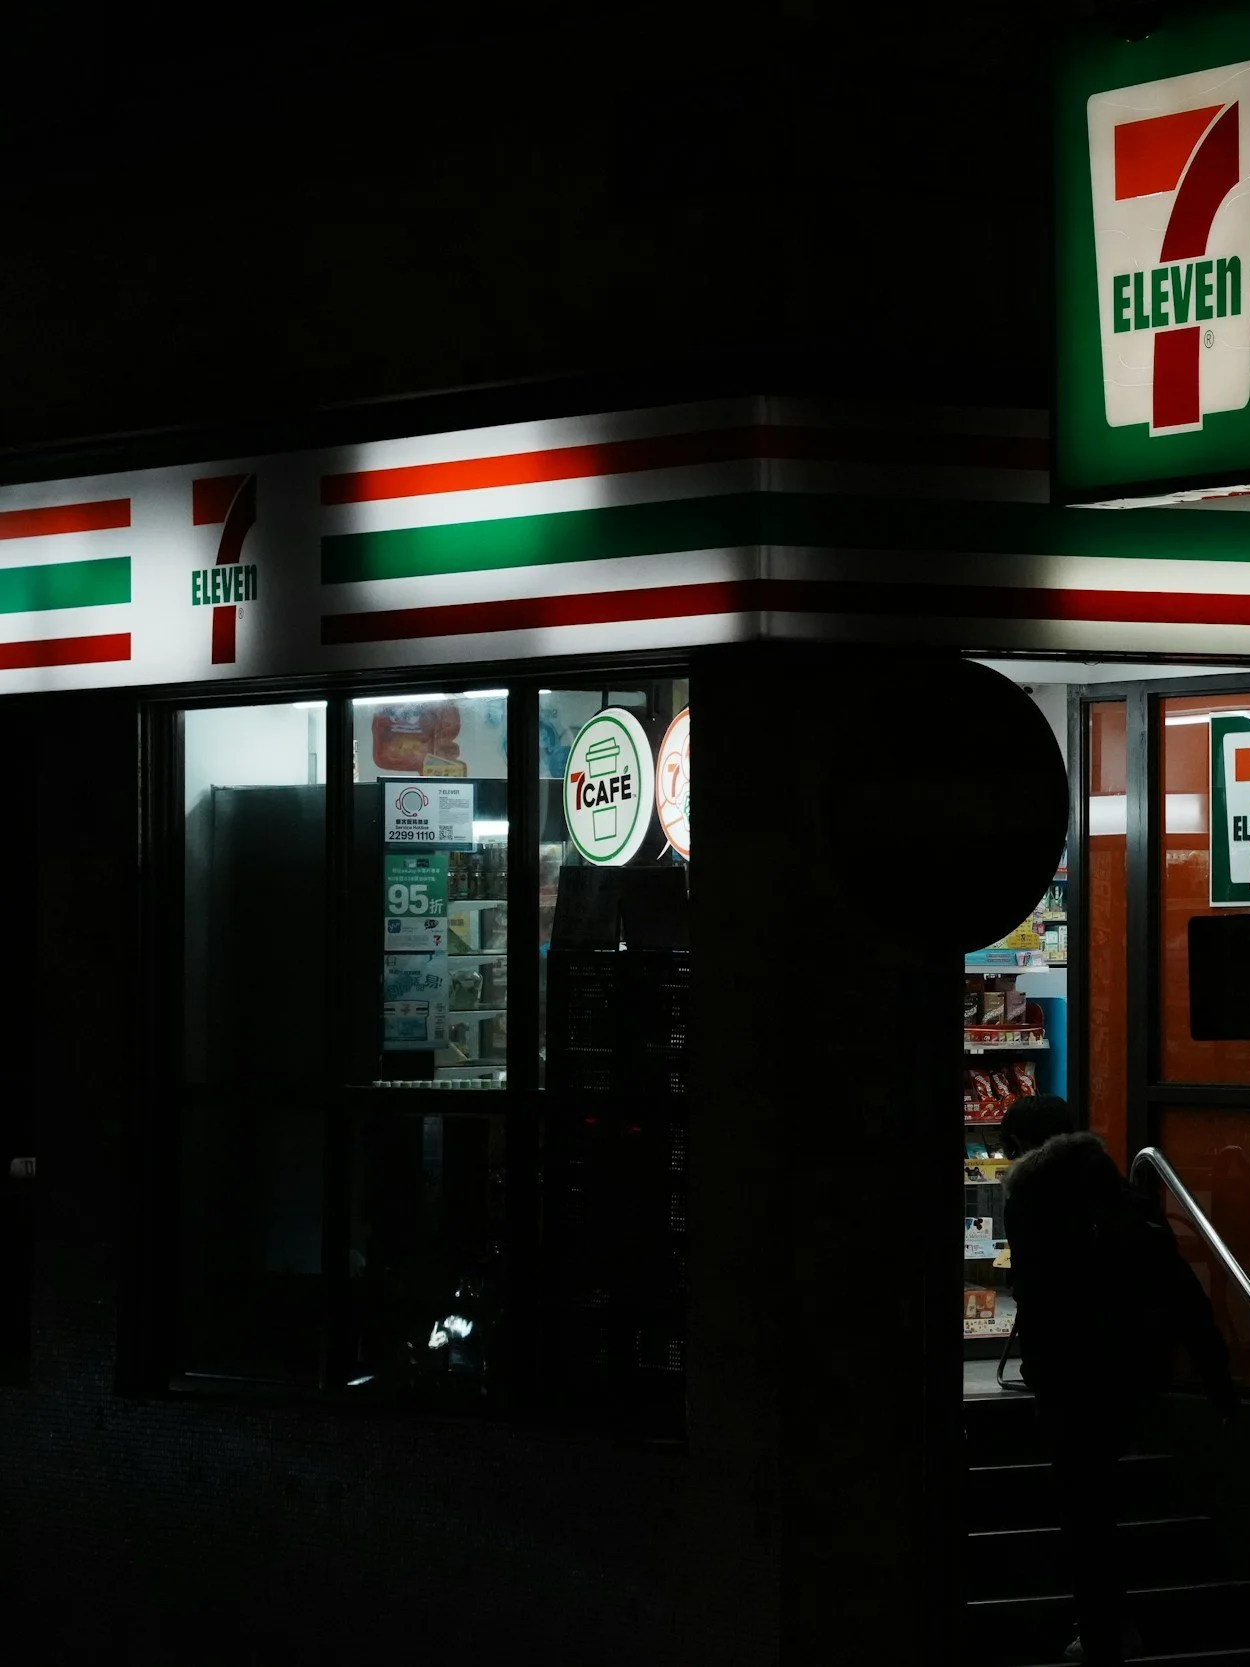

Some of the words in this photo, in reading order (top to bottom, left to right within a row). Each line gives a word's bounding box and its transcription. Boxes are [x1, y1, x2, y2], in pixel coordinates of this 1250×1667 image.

[1114, 100, 1240, 429] 7
[192, 473, 257, 665] 7
[389, 831, 414, 840] 2299
[416, 831, 436, 841] 1110
